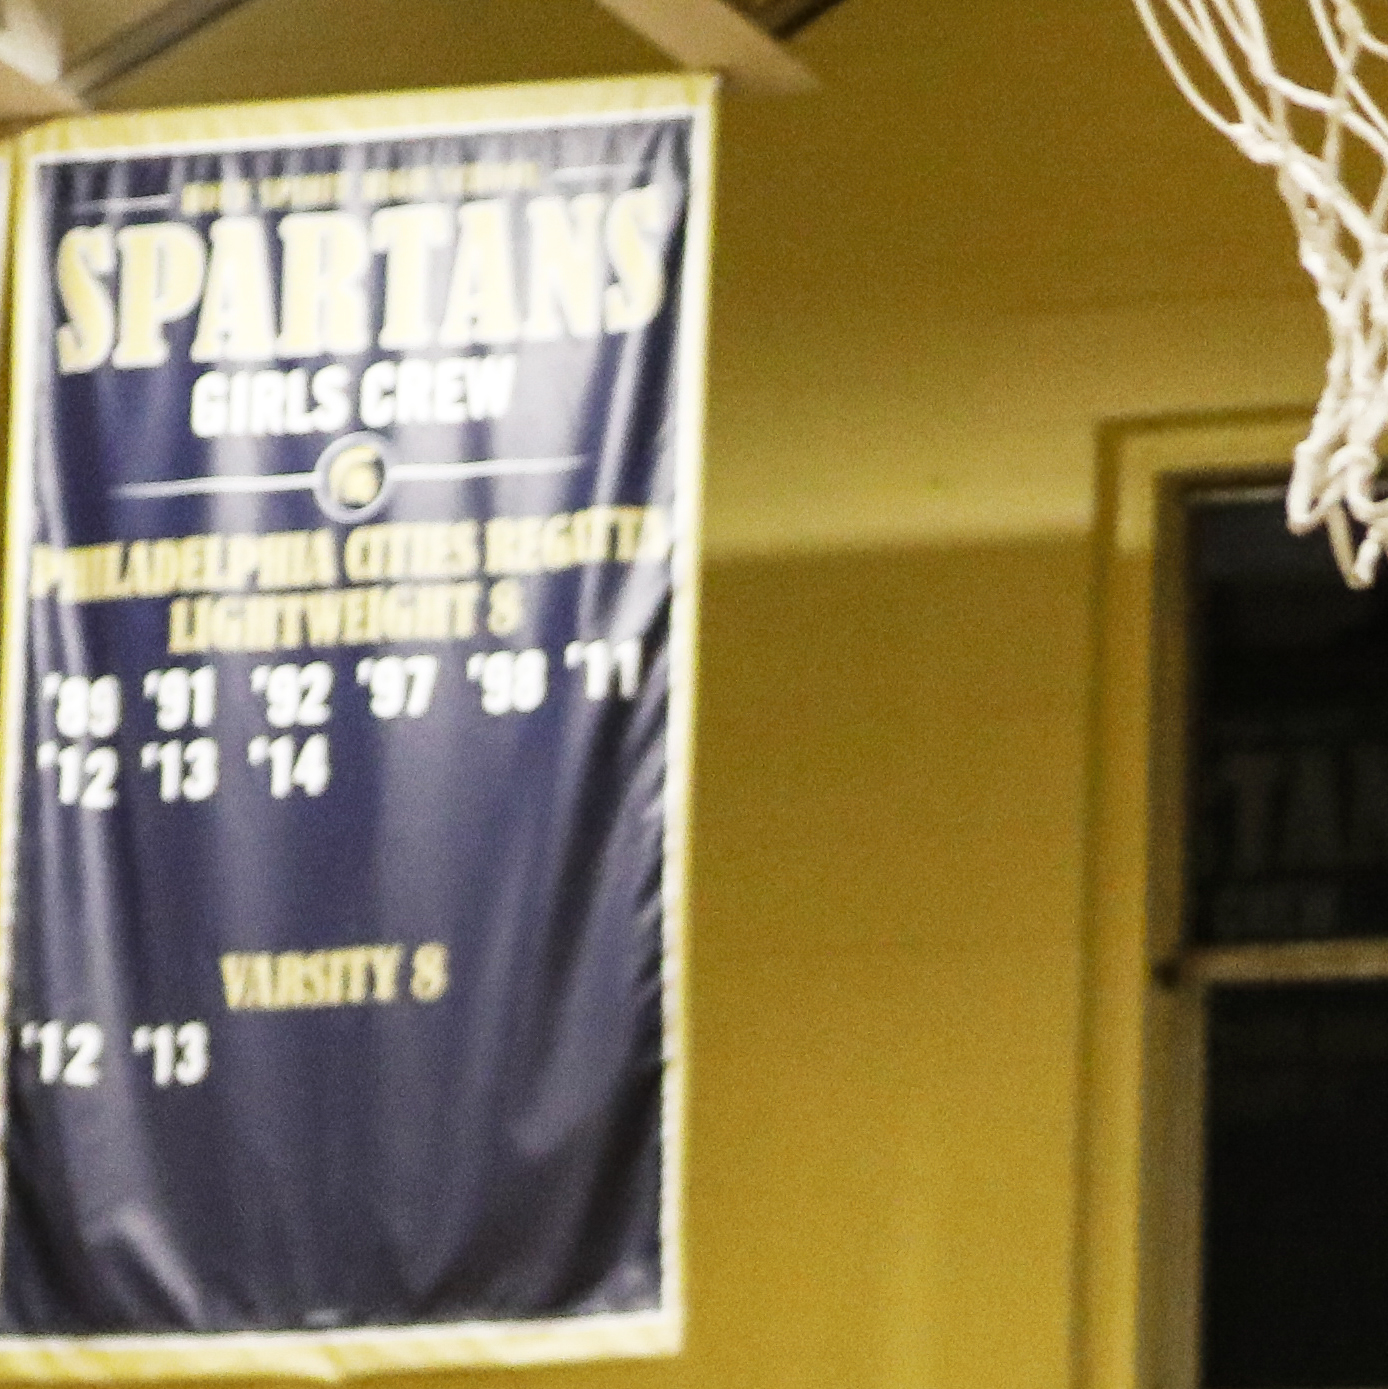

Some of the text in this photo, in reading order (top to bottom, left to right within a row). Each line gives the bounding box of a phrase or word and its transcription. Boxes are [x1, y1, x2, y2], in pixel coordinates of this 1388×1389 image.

[56, 184, 664, 374] SPARTANS
[190, 354, 517, 438] GIRLS CREW
[30, 526, 337, 604] PHILADELPHIA
[168, 578, 523, 654] LIGHTWEIGHT 8
[219, 942, 451, 1011] VARSITY 8
